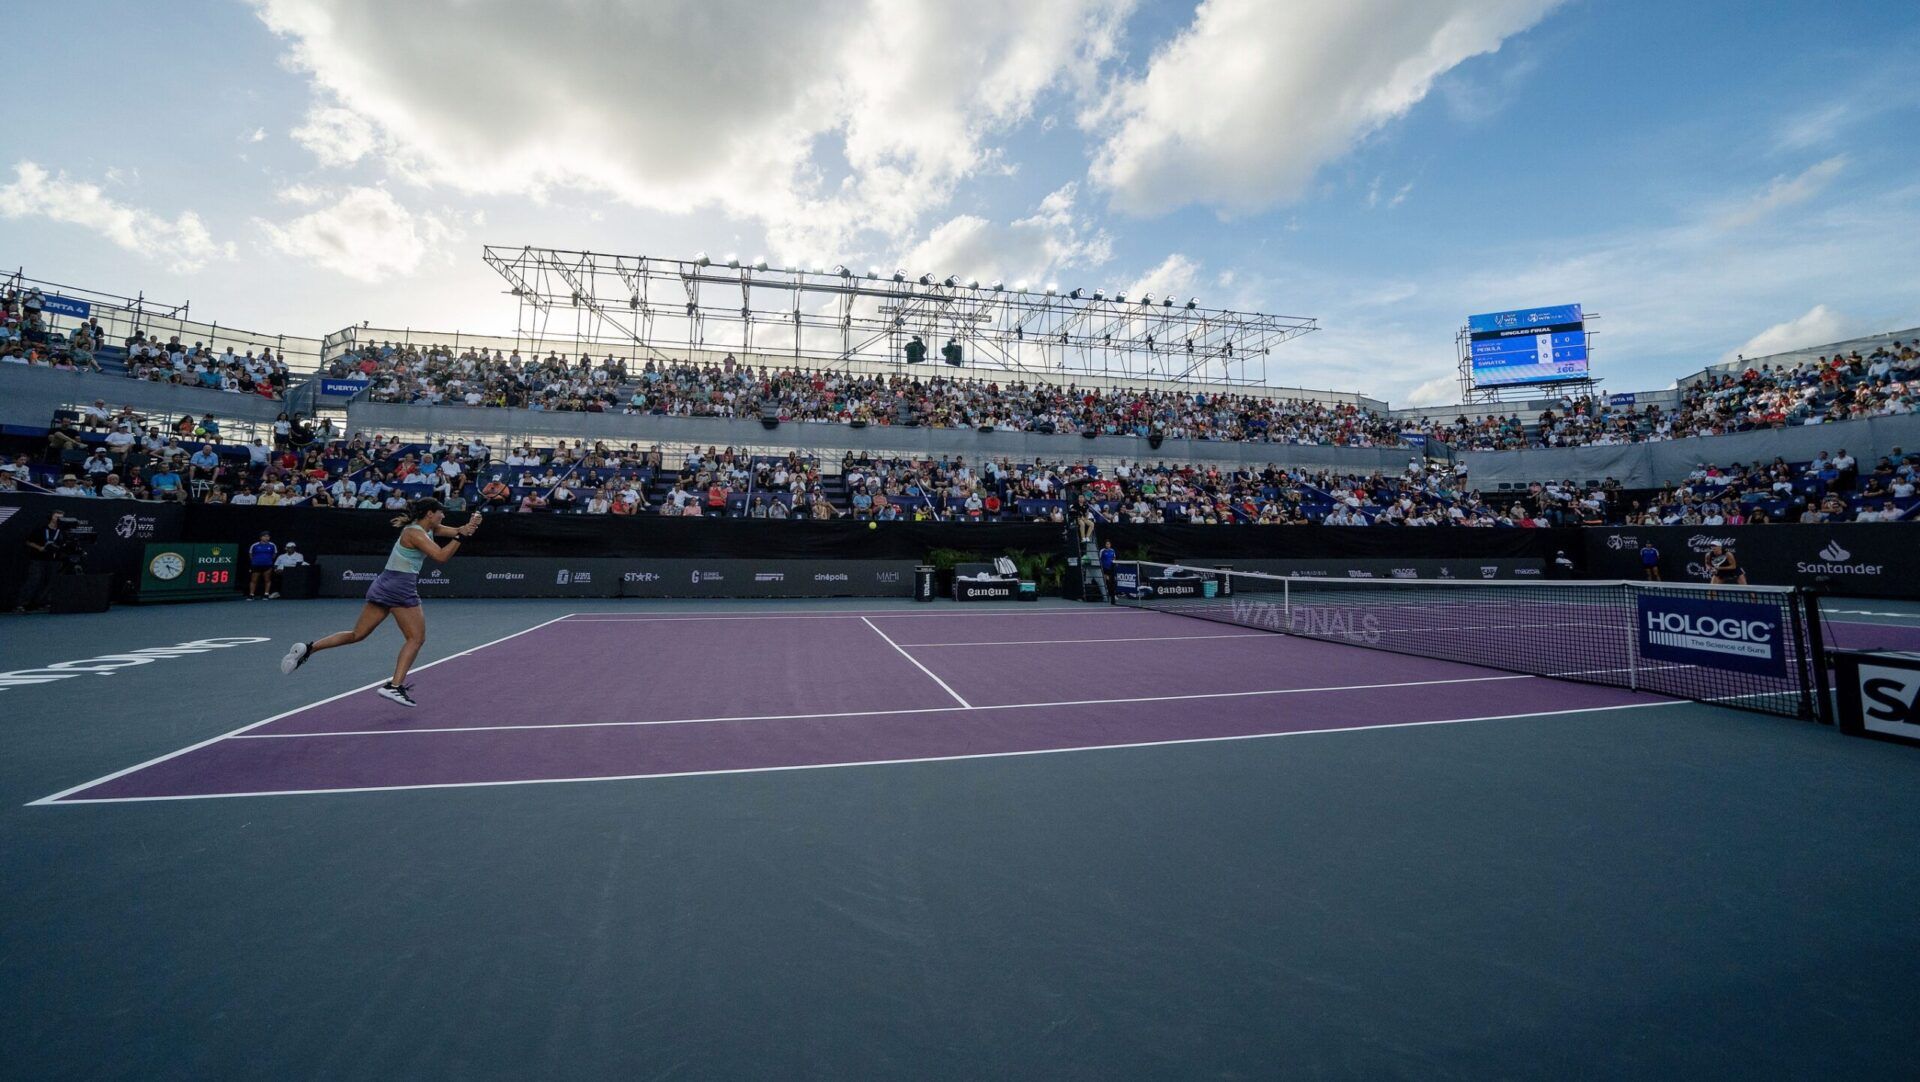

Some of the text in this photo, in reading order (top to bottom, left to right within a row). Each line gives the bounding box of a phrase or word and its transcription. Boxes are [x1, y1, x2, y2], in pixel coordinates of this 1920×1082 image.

[45, 301, 74, 311] ERTA
[1796, 562, 1883, 575] Santander
[197, 570, 229, 584] 0:36
[814, 573, 848, 582] cinépolis
[1232, 599, 1381, 644] WTA FINALS
[1647, 611, 1771, 642] HOLOGIC
[1706, 641, 1736, 651] Science
